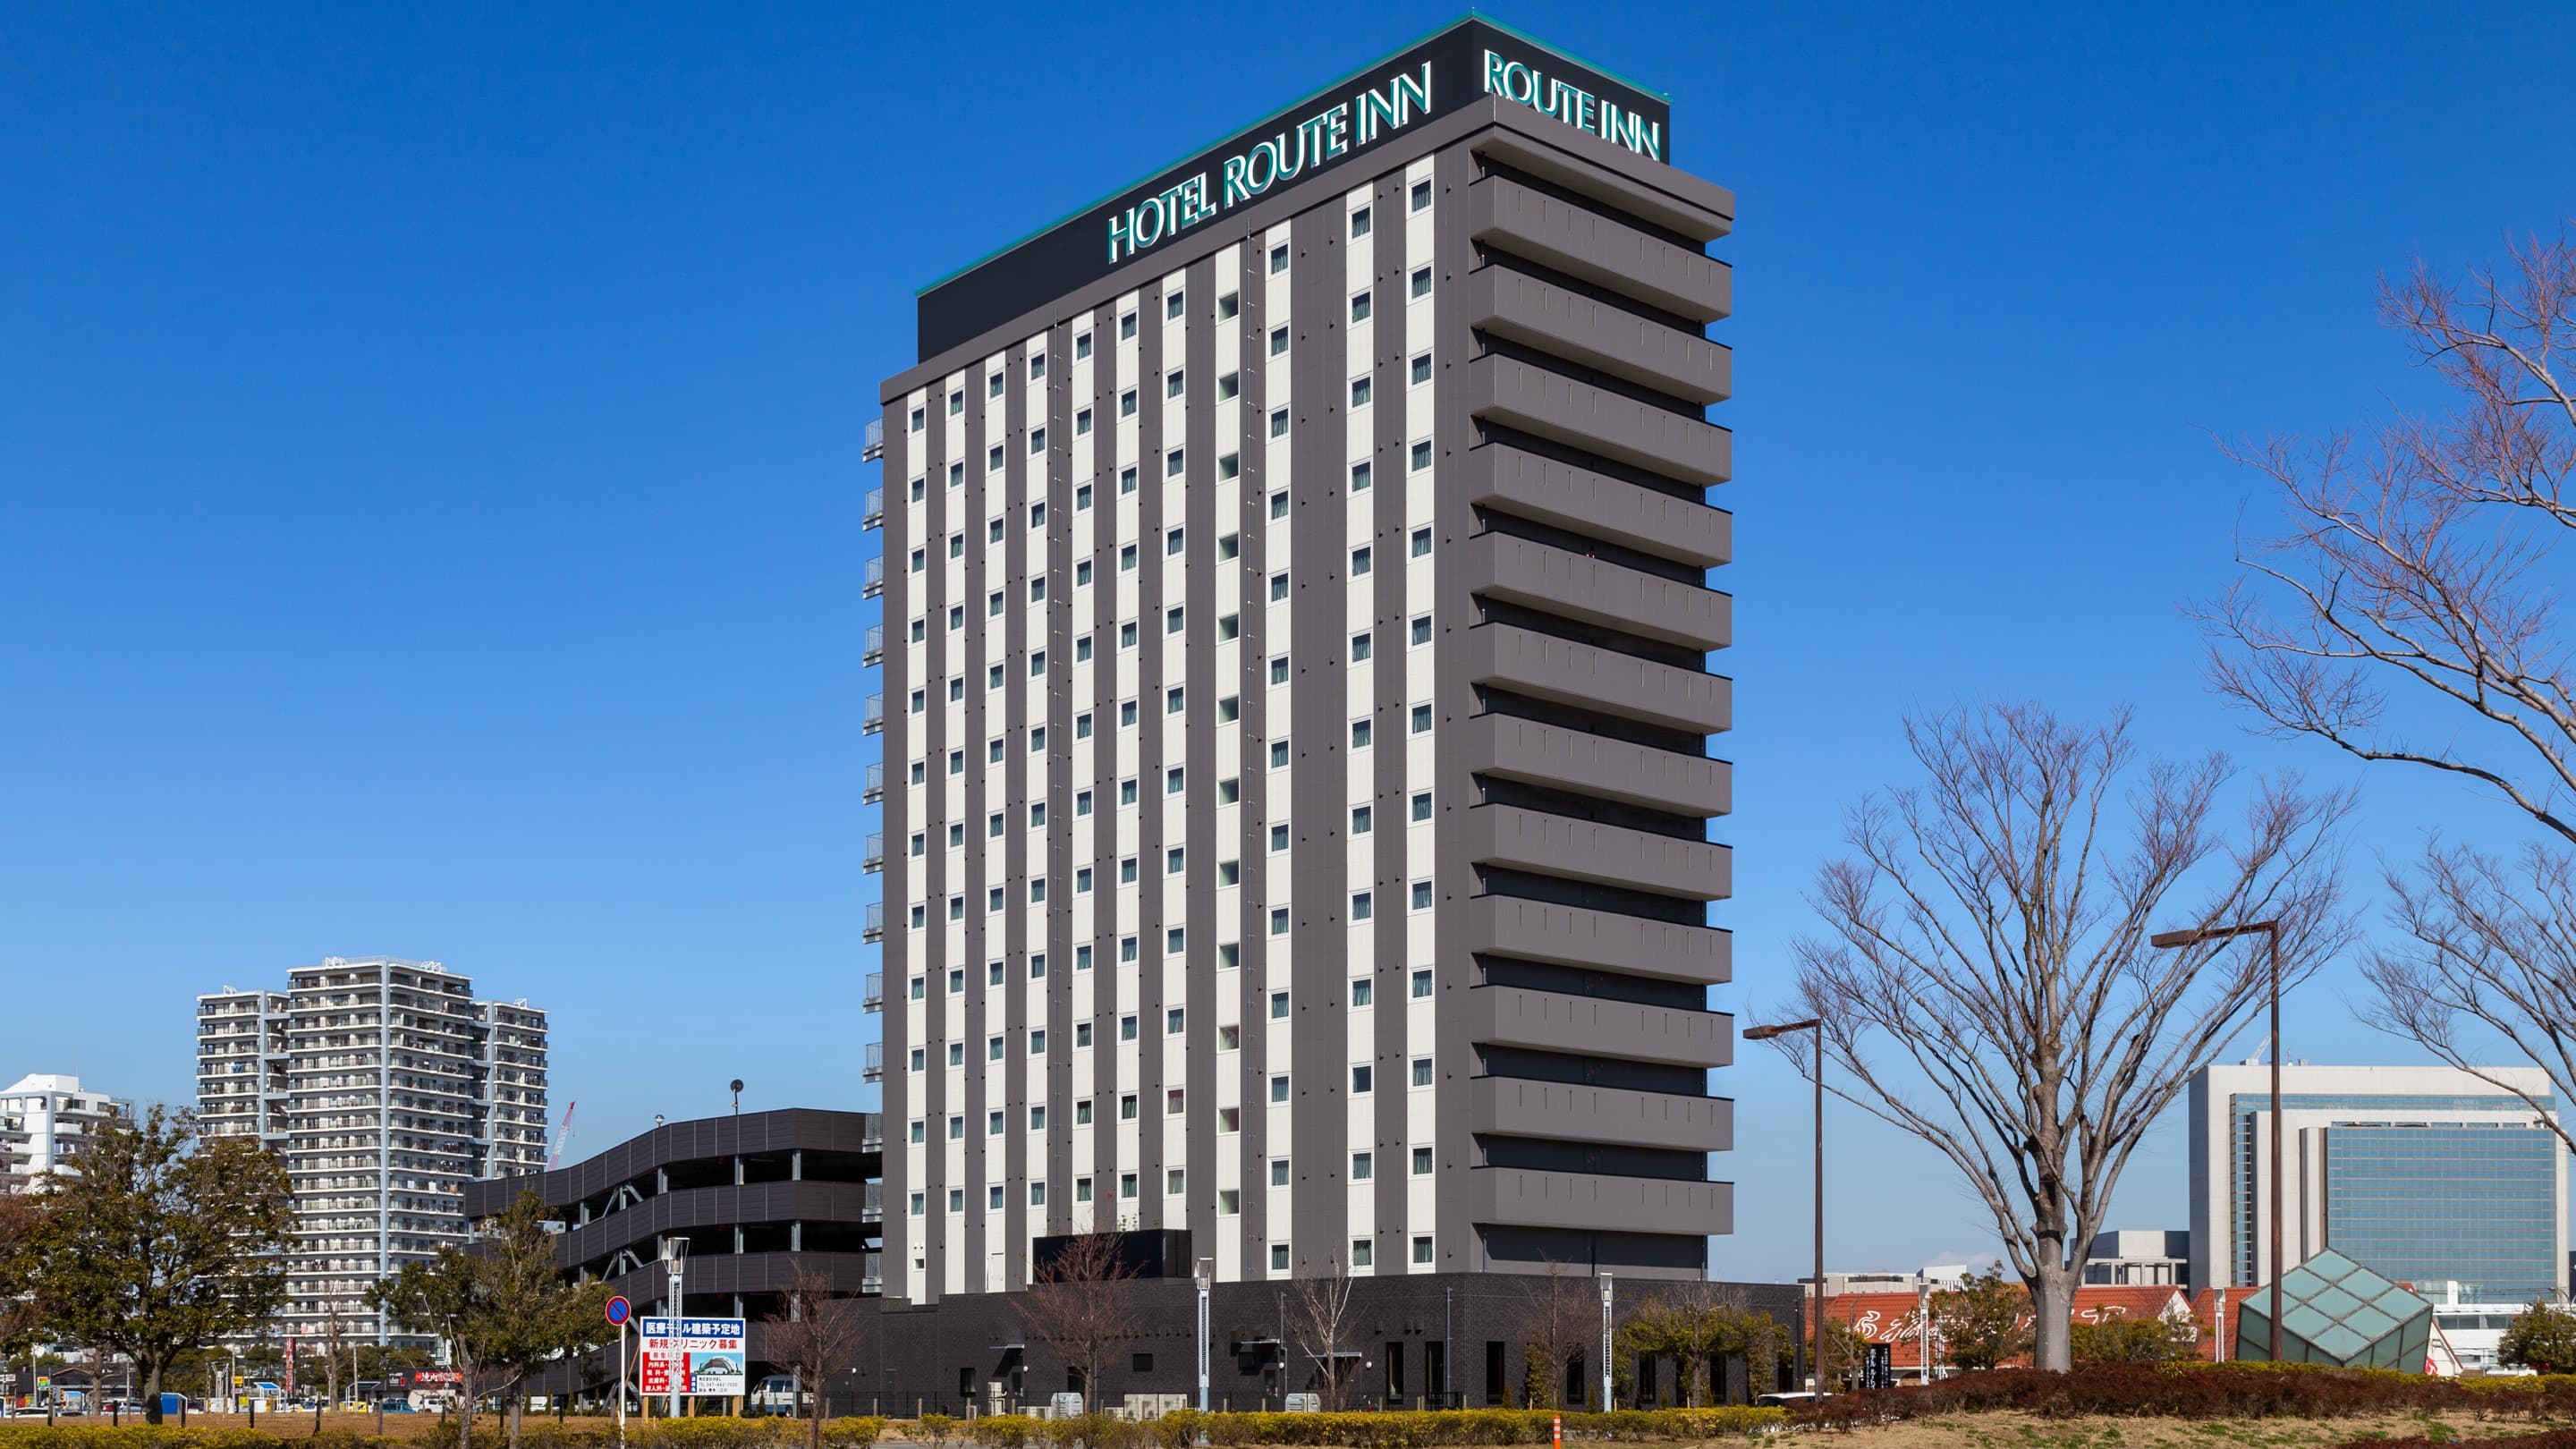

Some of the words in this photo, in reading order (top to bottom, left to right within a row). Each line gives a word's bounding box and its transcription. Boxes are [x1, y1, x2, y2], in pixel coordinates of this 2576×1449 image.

[1484, 48, 1596, 135] ROUTE
[1601, 99, 1661, 162] INN
[1108, 172, 1216, 265] HOTEL
[1224, 102, 1347, 209] ROUTE
[1356, 61, 1431, 147] INN
[646, 1322, 741, 1335] 医療ル建築予定地
